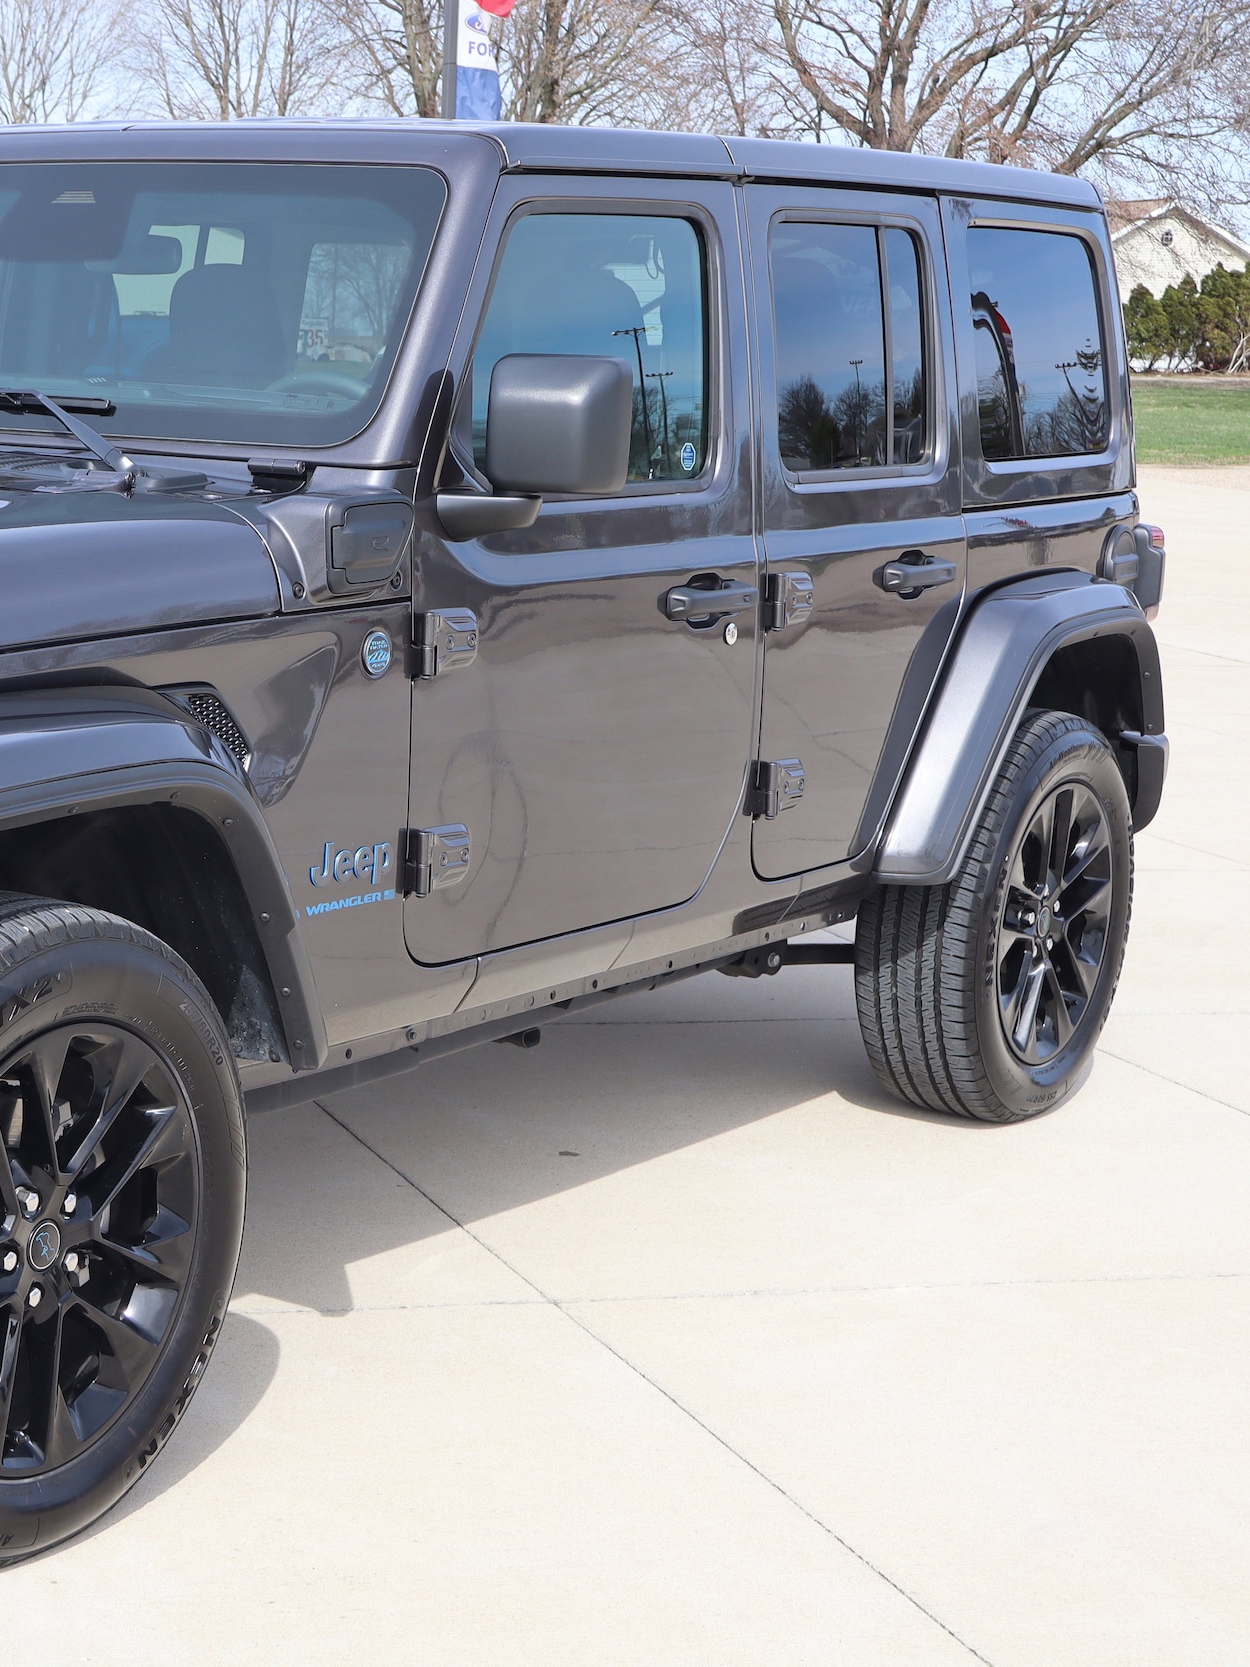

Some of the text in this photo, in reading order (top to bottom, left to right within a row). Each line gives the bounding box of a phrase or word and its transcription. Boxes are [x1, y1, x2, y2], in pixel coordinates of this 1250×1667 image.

[309, 841, 393, 888] Jeep
[305, 891, 382, 917] WRANGLER
[137, 1315, 222, 1471] NEXEN
